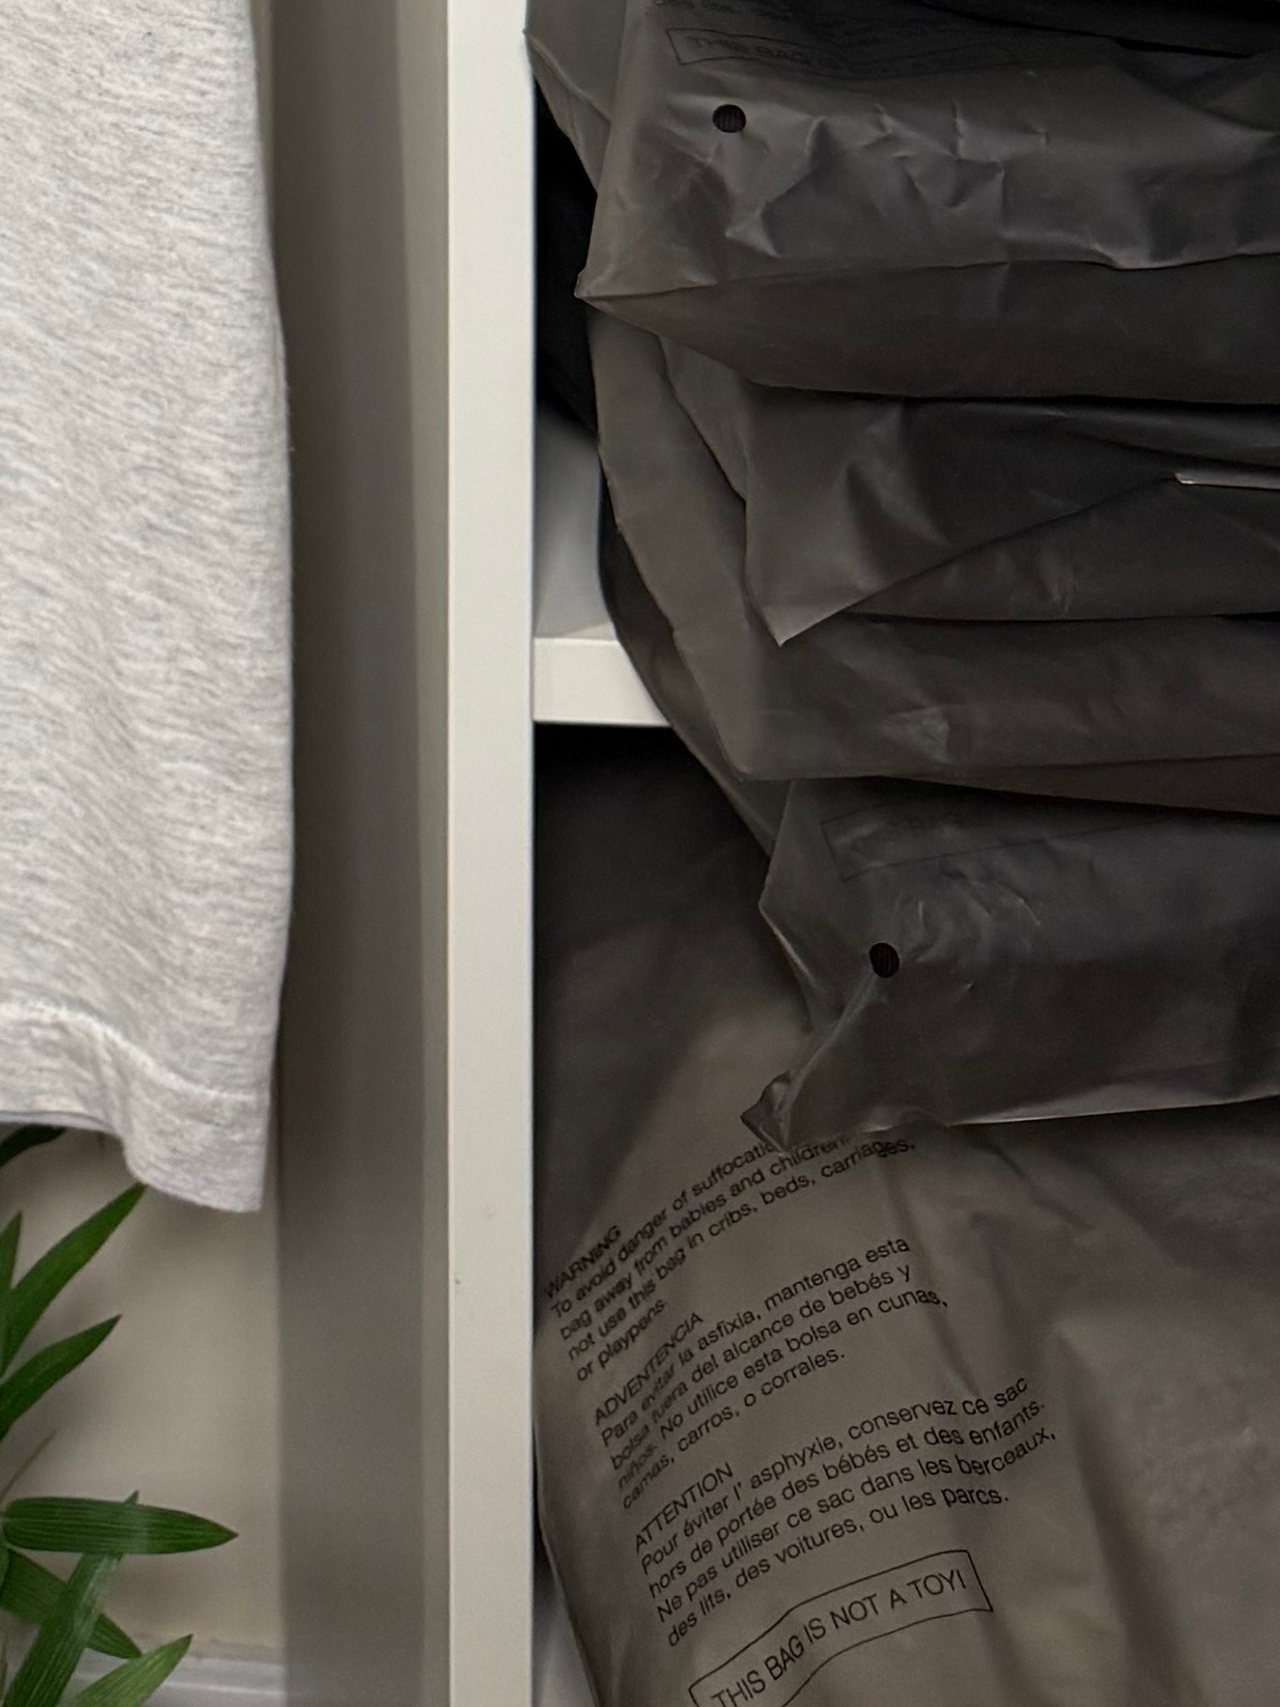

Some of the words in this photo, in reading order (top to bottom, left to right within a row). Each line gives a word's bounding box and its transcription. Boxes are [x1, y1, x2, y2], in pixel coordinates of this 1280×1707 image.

[545, 1225, 621, 1299] WARNING
[551, 1298, 573, 1318] To
[575, 1259, 617, 1301] avoid
[617, 1208, 668, 1263] danger
[672, 1189, 688, 1212] of
[560, 1309, 593, 1341] bag
[593, 1271, 633, 1313] away
[634, 1235, 669, 1276] from
[668, 1192, 728, 1239] babies
[729, 1168, 766, 1198] and
[568, 1331, 596, 1362] not
[597, 1306, 627, 1338] use
[654, 1247, 687, 1281] bag
[688, 1231, 705, 1251] in
[759, 1174, 816, 1206] beds,
[820, 1137, 917, 1179] carriages.
[690, 1353, 720, 1385] del
[722, 1311, 796, 1364] alcance
[798, 1297, 827, 1320] de
[827, 1269, 895, 1308] bebés
[896, 1263, 912, 1284] y
[576, 1361, 594, 1382] or
[601, 1410, 639, 1448] Para
[678, 1347, 695, 1367] la
[697, 1309, 763, 1352] asfixia,
[763, 1256, 863, 1312] mantenga
[865, 1237, 911, 1264] esta
[658, 1411, 685, 1441] No
[686, 1373, 740, 1417] utilice
[742, 1347, 785, 1380] esta
[784, 1318, 843, 1355] bolsa
[845, 1306, 874, 1327] en
[876, 1287, 949, 1315] cunas,
[622, 1455, 676, 1511] camas,
[676, 1404, 741, 1454] carros,
[743, 1391, 758, 1408] o
[760, 1347, 846, 1397] corrales.
[633, 1460, 734, 1555] ATTENTION
[640, 1531, 680, 1576] Pour
[682, 1494, 730, 1539] éviter
[749, 1435, 845, 1491] asphyxie,
[846, 1398, 960, 1441] conservez
[961, 1397, 990, 1417] ce
[993, 1376, 1029, 1409] sac
[647, 1559, 688, 1599] hors
[689, 1538, 714, 1564] de
[716, 1494, 778, 1548] portée
[781, 1471, 821, 1501] des
[822, 1442, 892, 1482] bébés
[895, 1432, 920, 1454] et
[923, 1426, 966, 1447] des
[968, 1399, 1047, 1445] enfants.
[655, 1593, 684, 1624] Ne
[684, 1564, 719, 1603] pas
[720, 1520, 782, 1569] utiliser
[786, 1506, 813, 1529] ce
[816, 1486, 857, 1515] sac
[859, 1466, 916, 1497] dans
[916, 1457, 954, 1479] les
[955, 1426, 1058, 1477] berceaux,
[666, 1611, 699, 1647] des
[698, 1587, 733, 1617] lits,
[734, 1557, 772, 1589] des
[773, 1517, 866, 1565] voitures,
[868, 1502, 900, 1525] ou
[900, 1490, 938, 1514] les
[940, 1487, 1010, 1509] parcs.
[709, 1669, 768, 1707] THIS
[763, 1634, 806, 1682] BAG
[802, 1616, 828, 1646] IS
[828, 1592, 882, 1631] NOT
[888, 1587, 909, 1611] A
